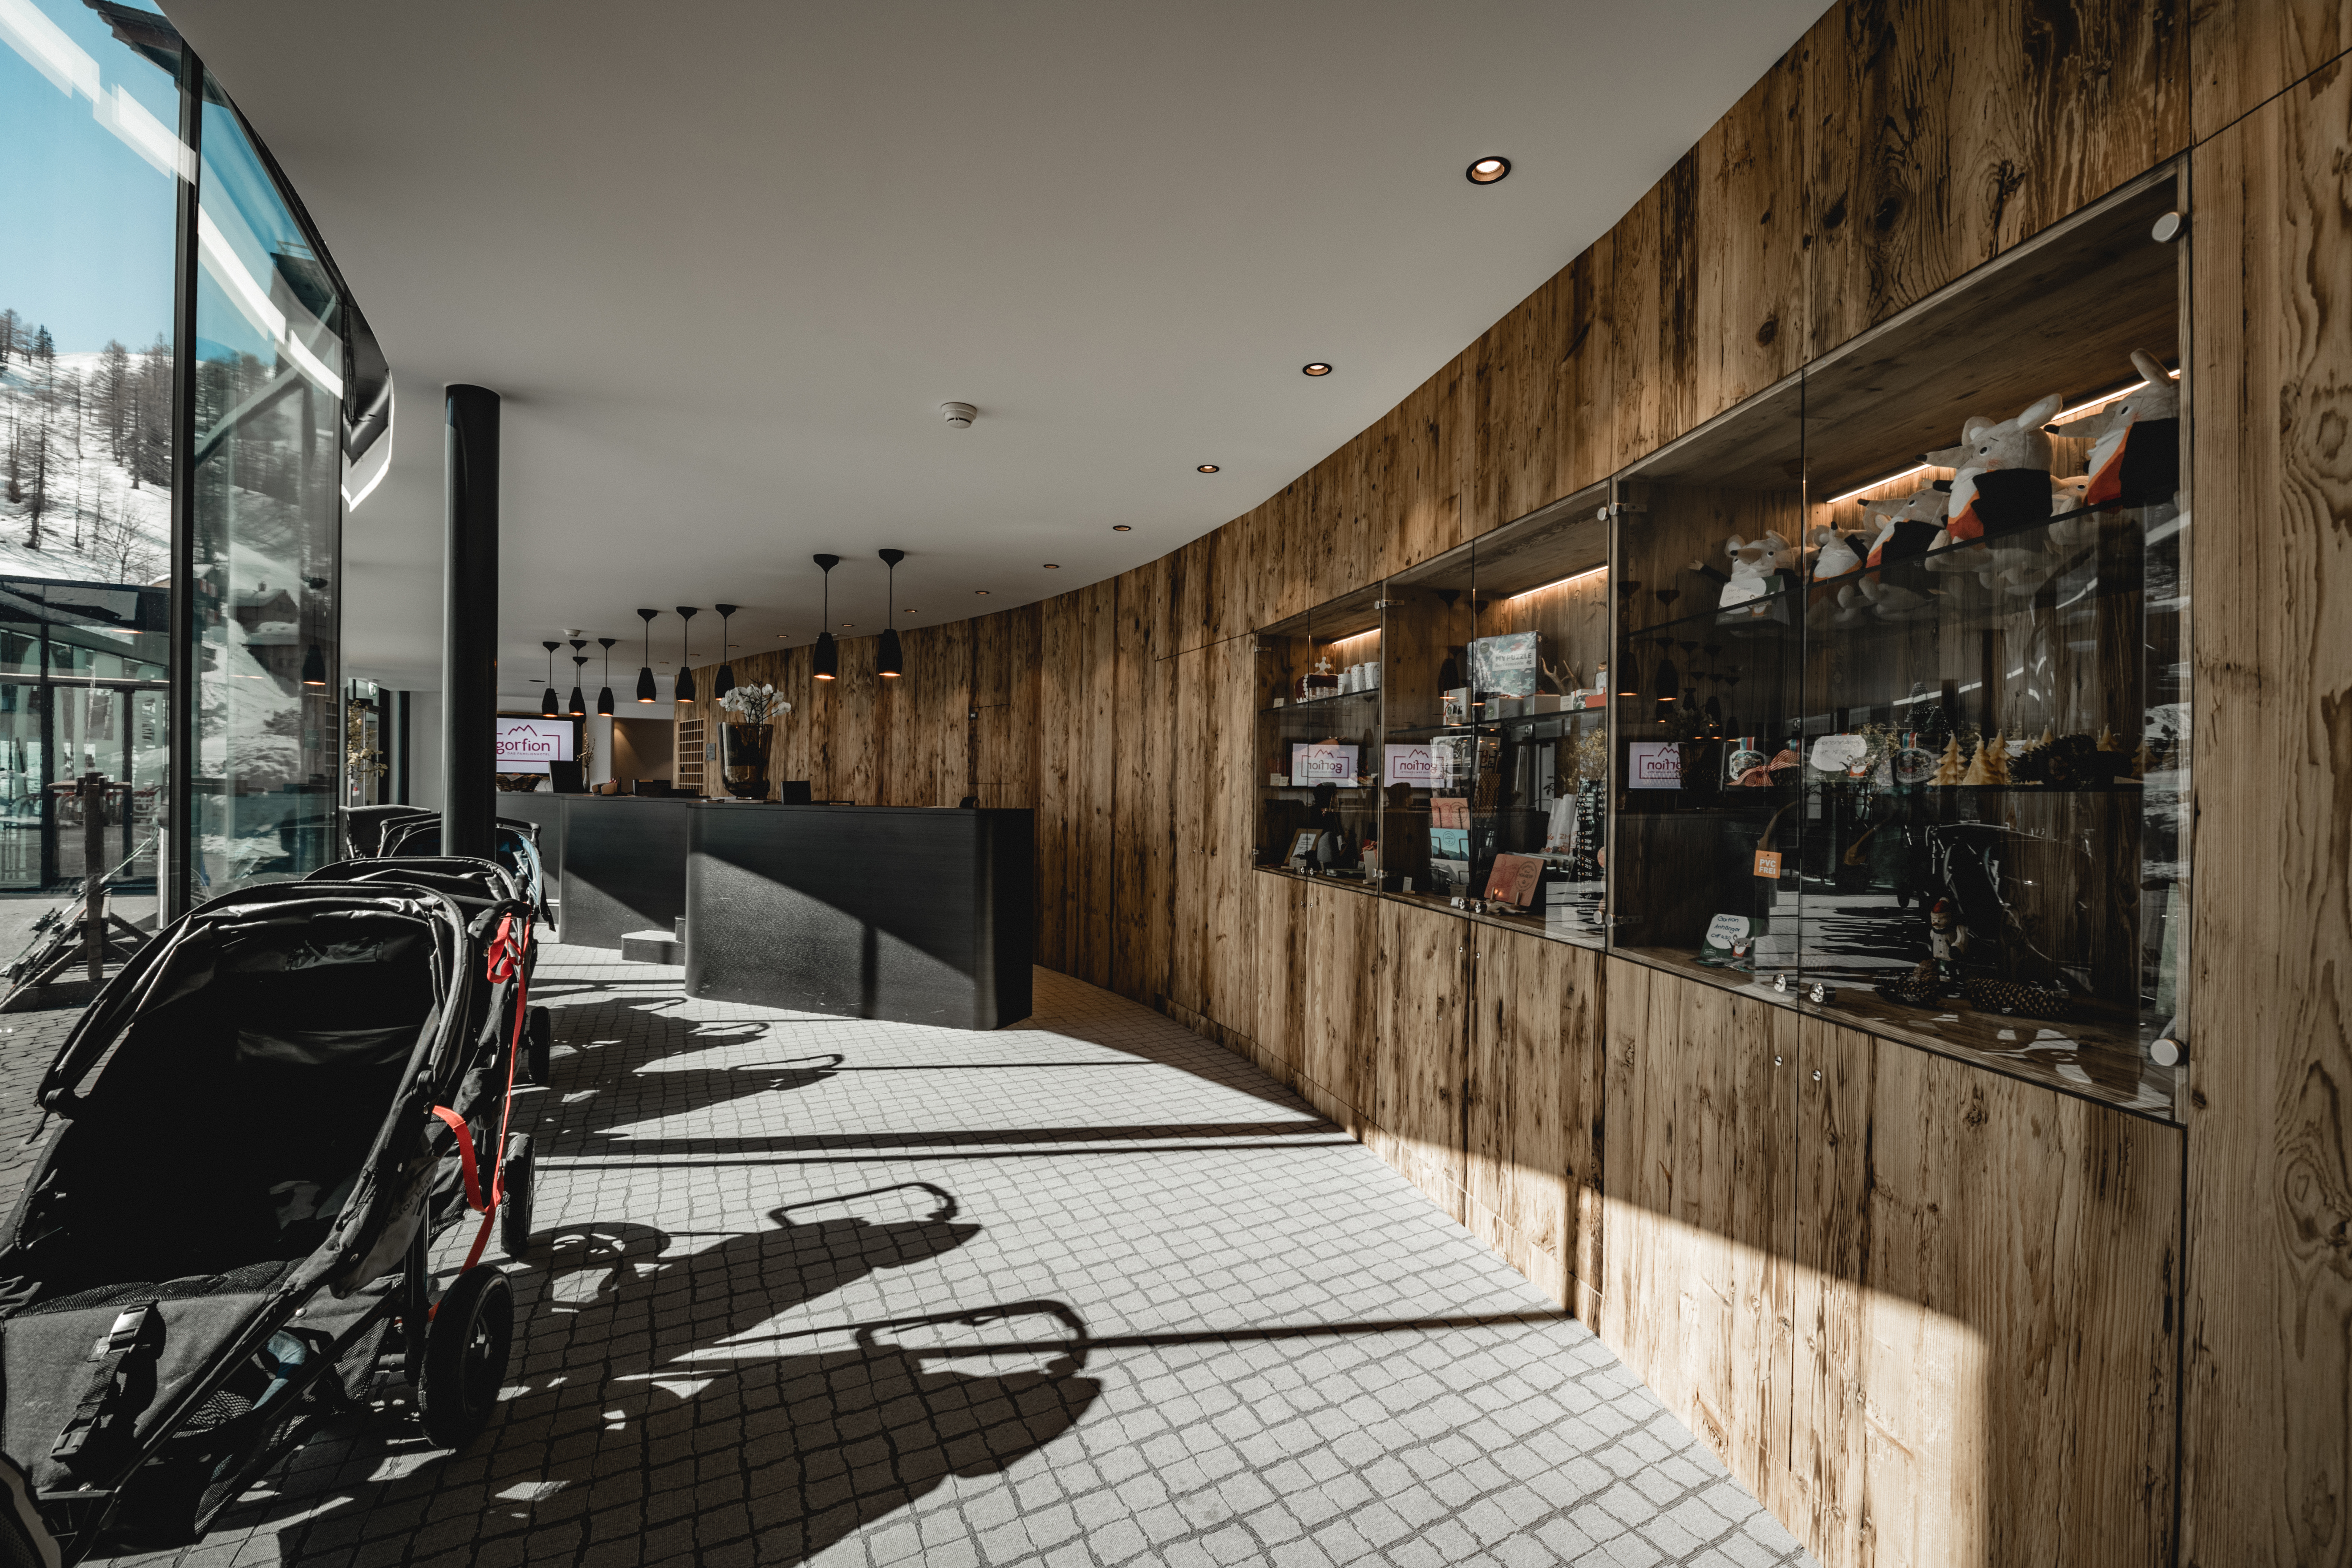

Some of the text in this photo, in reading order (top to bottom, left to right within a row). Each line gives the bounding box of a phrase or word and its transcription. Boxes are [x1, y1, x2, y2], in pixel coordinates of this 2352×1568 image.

[1495, 653, 1532, 661] MYPUZZLE
[497, 738, 550, 755] gorfion
[1759, 858, 1776, 867] PVC
[1759, 866, 1775, 874] FREI
[398, 1198, 413, 1215] for
